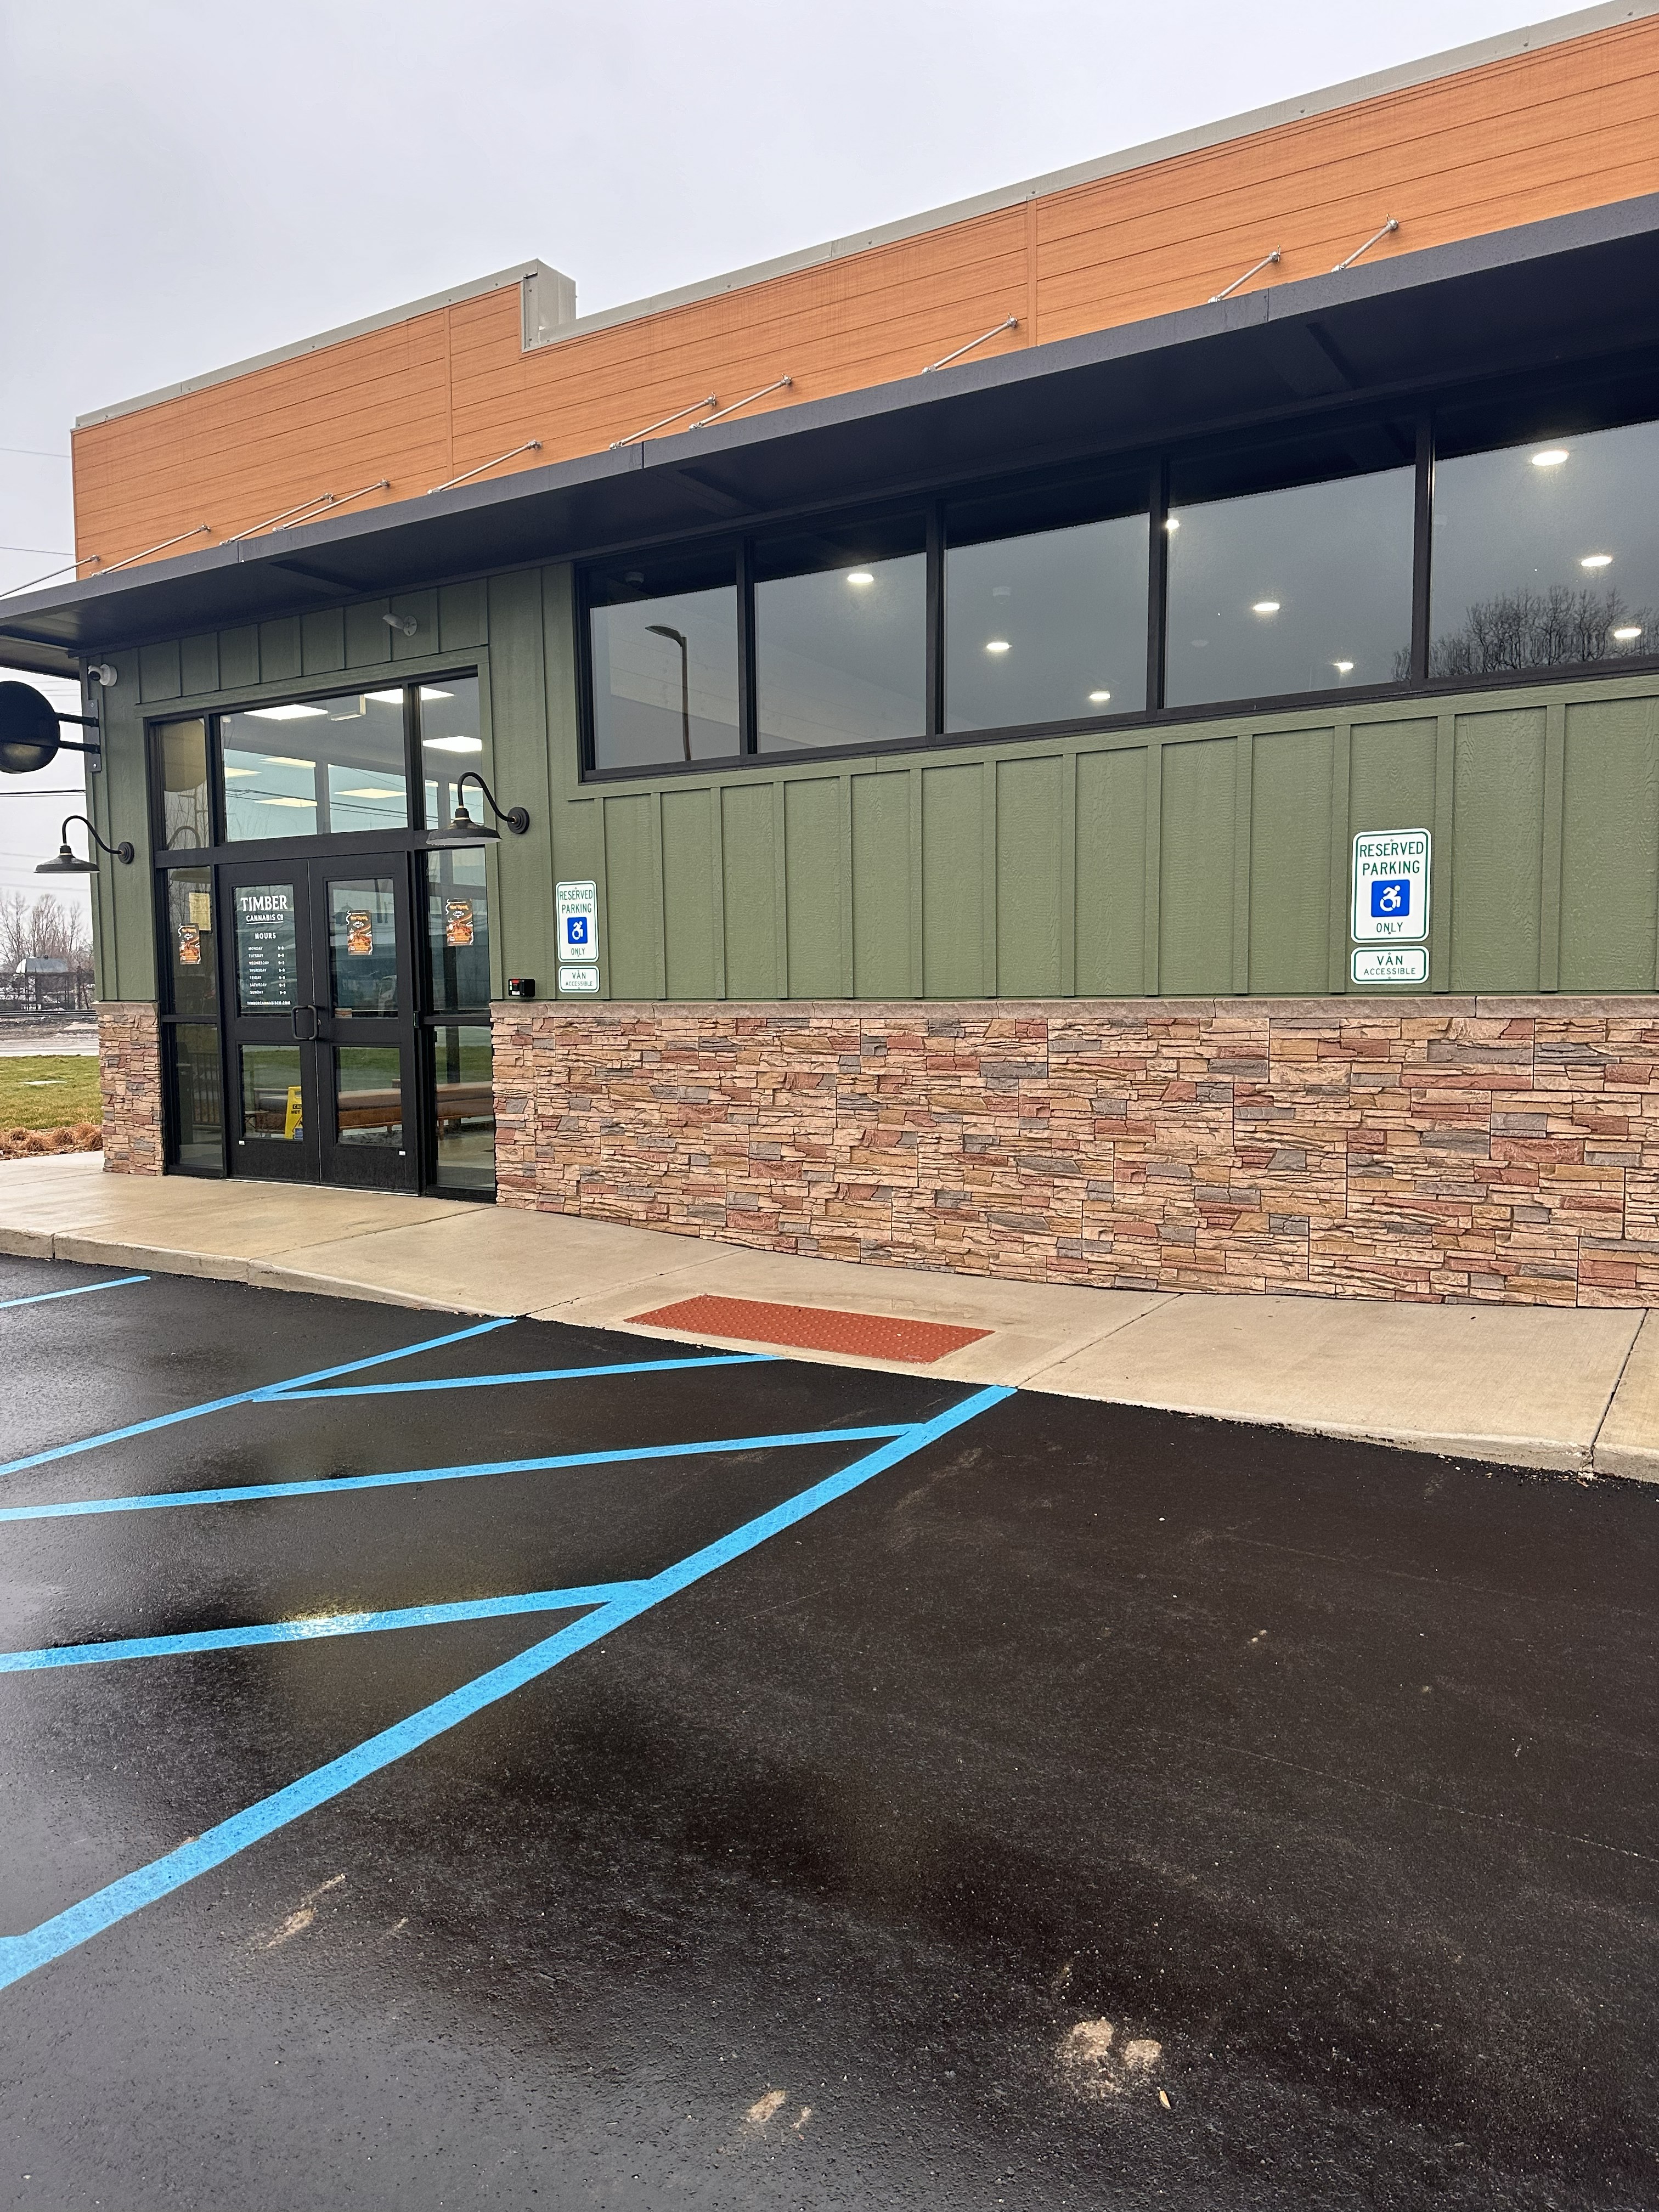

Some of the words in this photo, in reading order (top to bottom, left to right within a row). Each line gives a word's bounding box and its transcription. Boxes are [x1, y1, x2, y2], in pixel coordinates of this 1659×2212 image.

[1359, 841, 1424, 857] RESERVED
[1362, 860, 1420, 876] PARKING
[560, 889, 593, 900] RESERVED
[240, 895, 288, 912] TIMBER
[562, 903, 592, 913] PARKING
[1376, 922, 1403, 933] ONLY
[571, 947, 585, 956] ONLY
[1377, 955, 1403, 966] VAN
[572, 972, 586, 980] VAN
[1364, 967, 1416, 975] ACCESSIBLE
